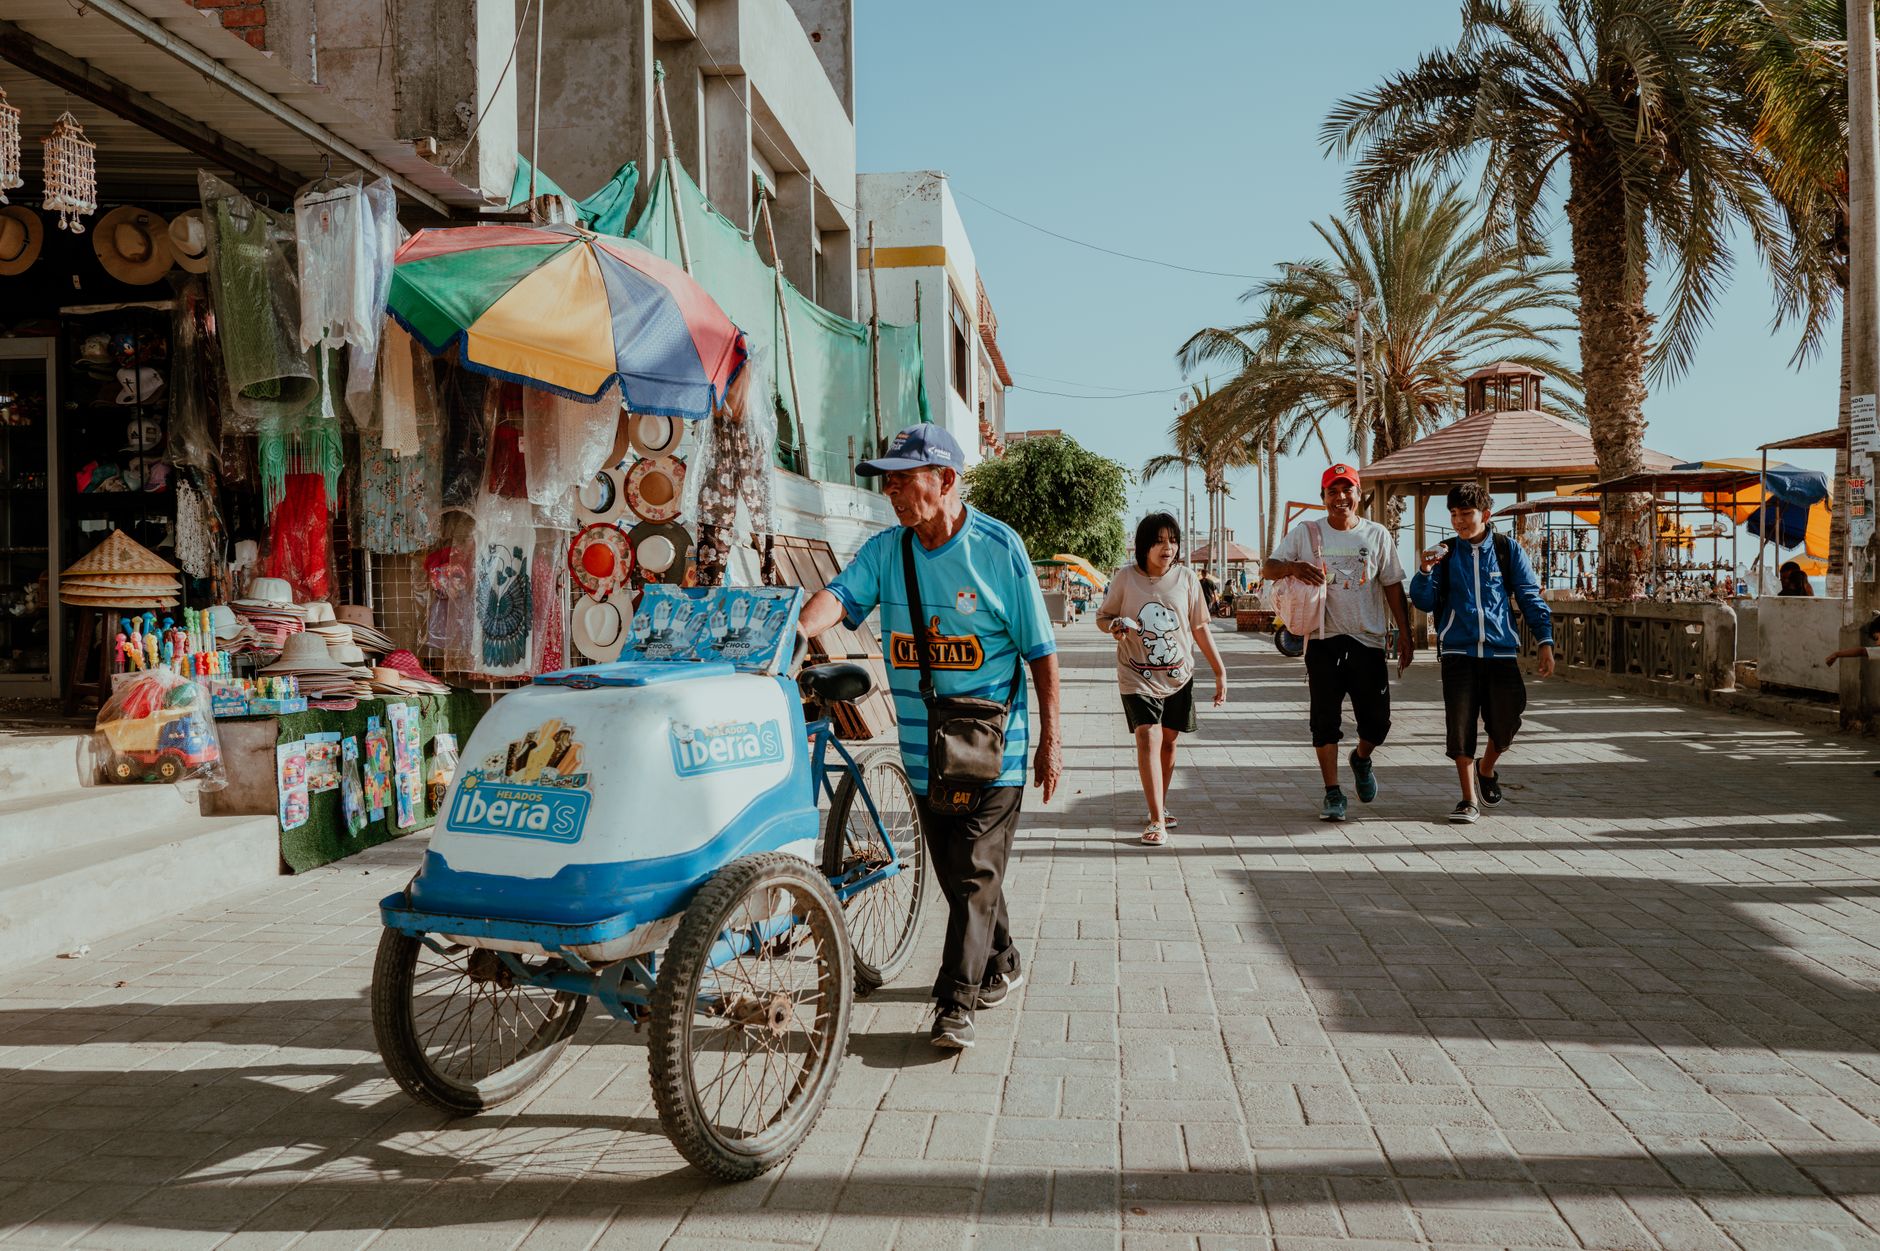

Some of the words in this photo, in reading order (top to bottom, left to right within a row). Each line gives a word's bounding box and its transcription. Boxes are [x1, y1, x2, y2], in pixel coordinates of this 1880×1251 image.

[898, 641, 972, 662] CRSTAL
[496, 790, 543, 802] HELADOS
[953, 791, 971, 804] CAT
